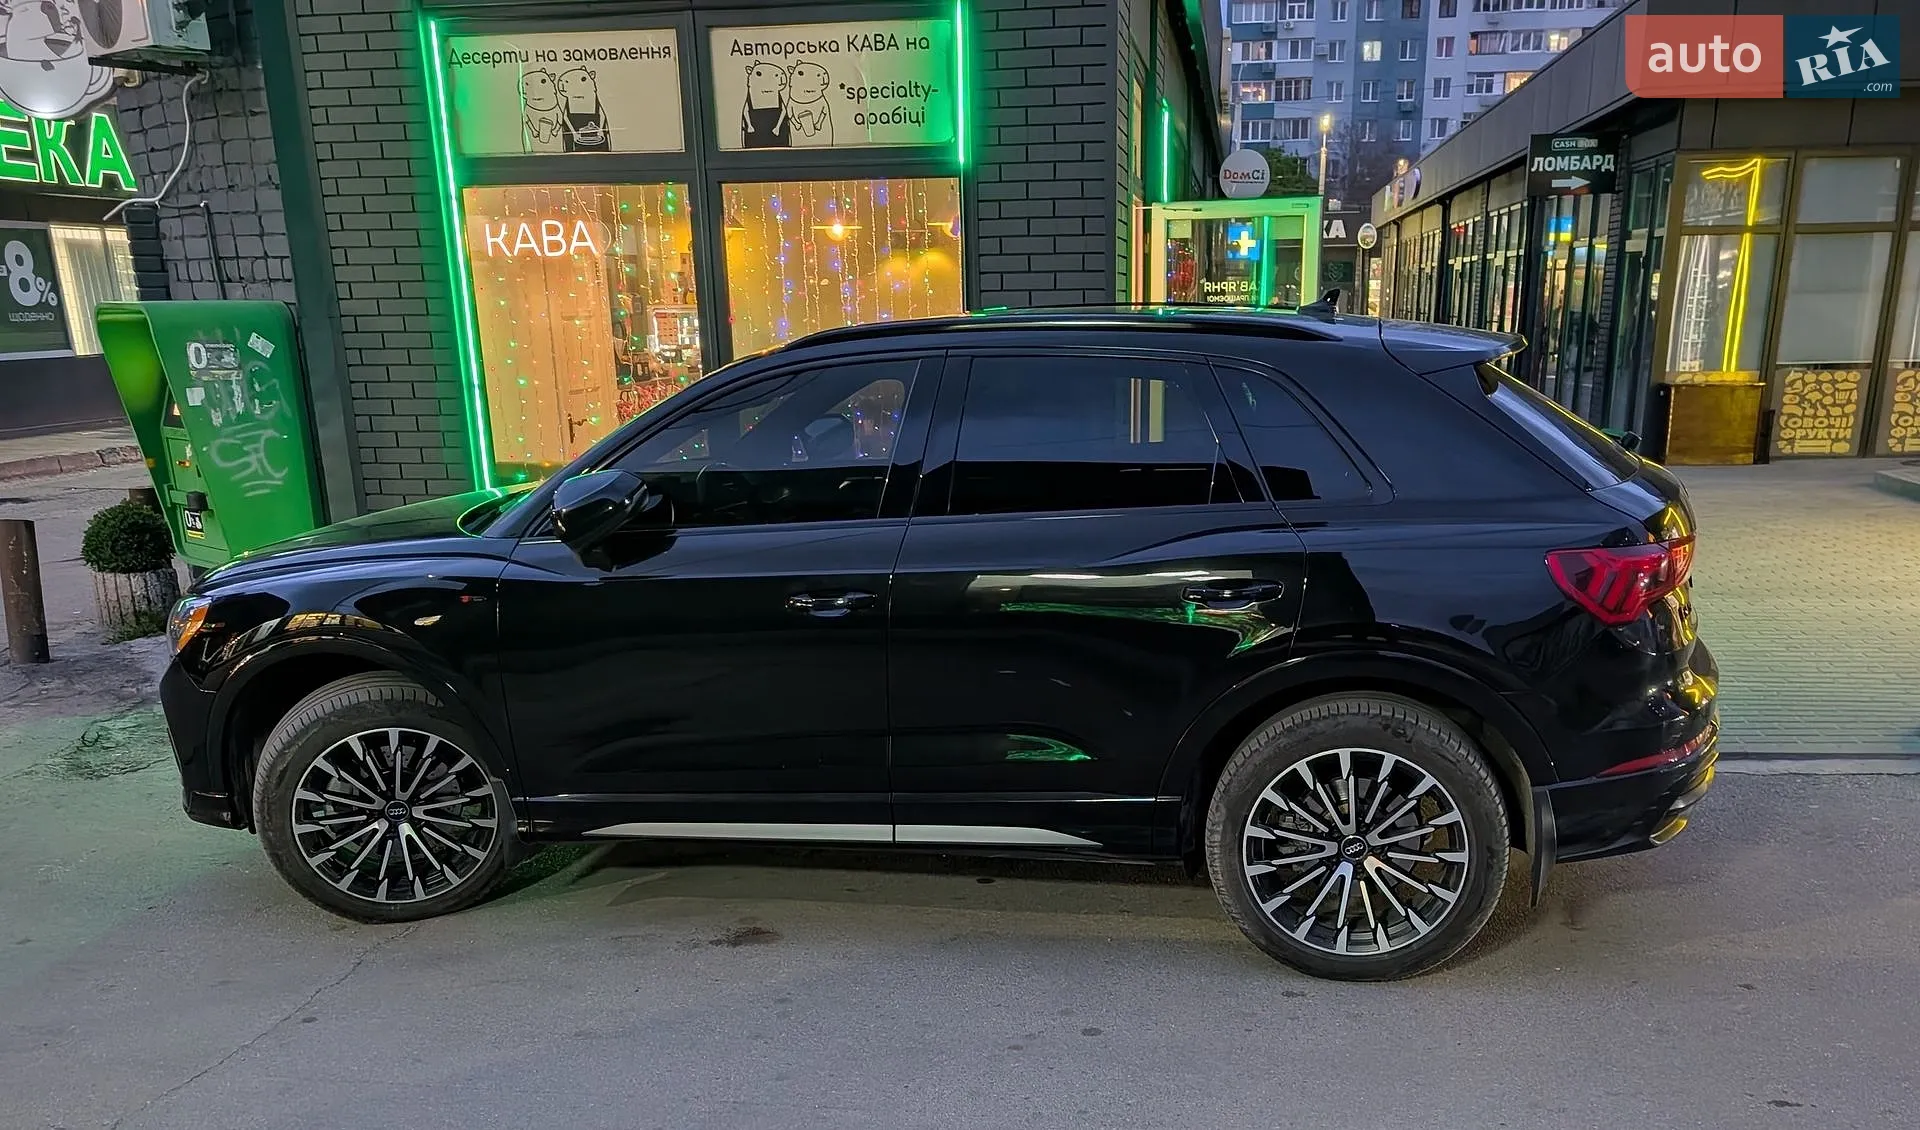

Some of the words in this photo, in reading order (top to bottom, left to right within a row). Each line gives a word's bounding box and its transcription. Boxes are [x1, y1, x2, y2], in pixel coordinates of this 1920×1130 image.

[448, 48, 528, 69] Десерти
[535, 49, 558, 62] на
[563, 46, 672, 64] замовлення
[730, 39, 840, 59] Авторська
[847, 33, 900, 52] КАВА
[906, 36, 930, 50] на
[1531, 154, 1615, 172] ЛОМБАРД
[484, 219, 599, 258] КАВА
[4, 240, 58, 306] 8%
[1780, 427, 1853, 440] ФРУКТИ
